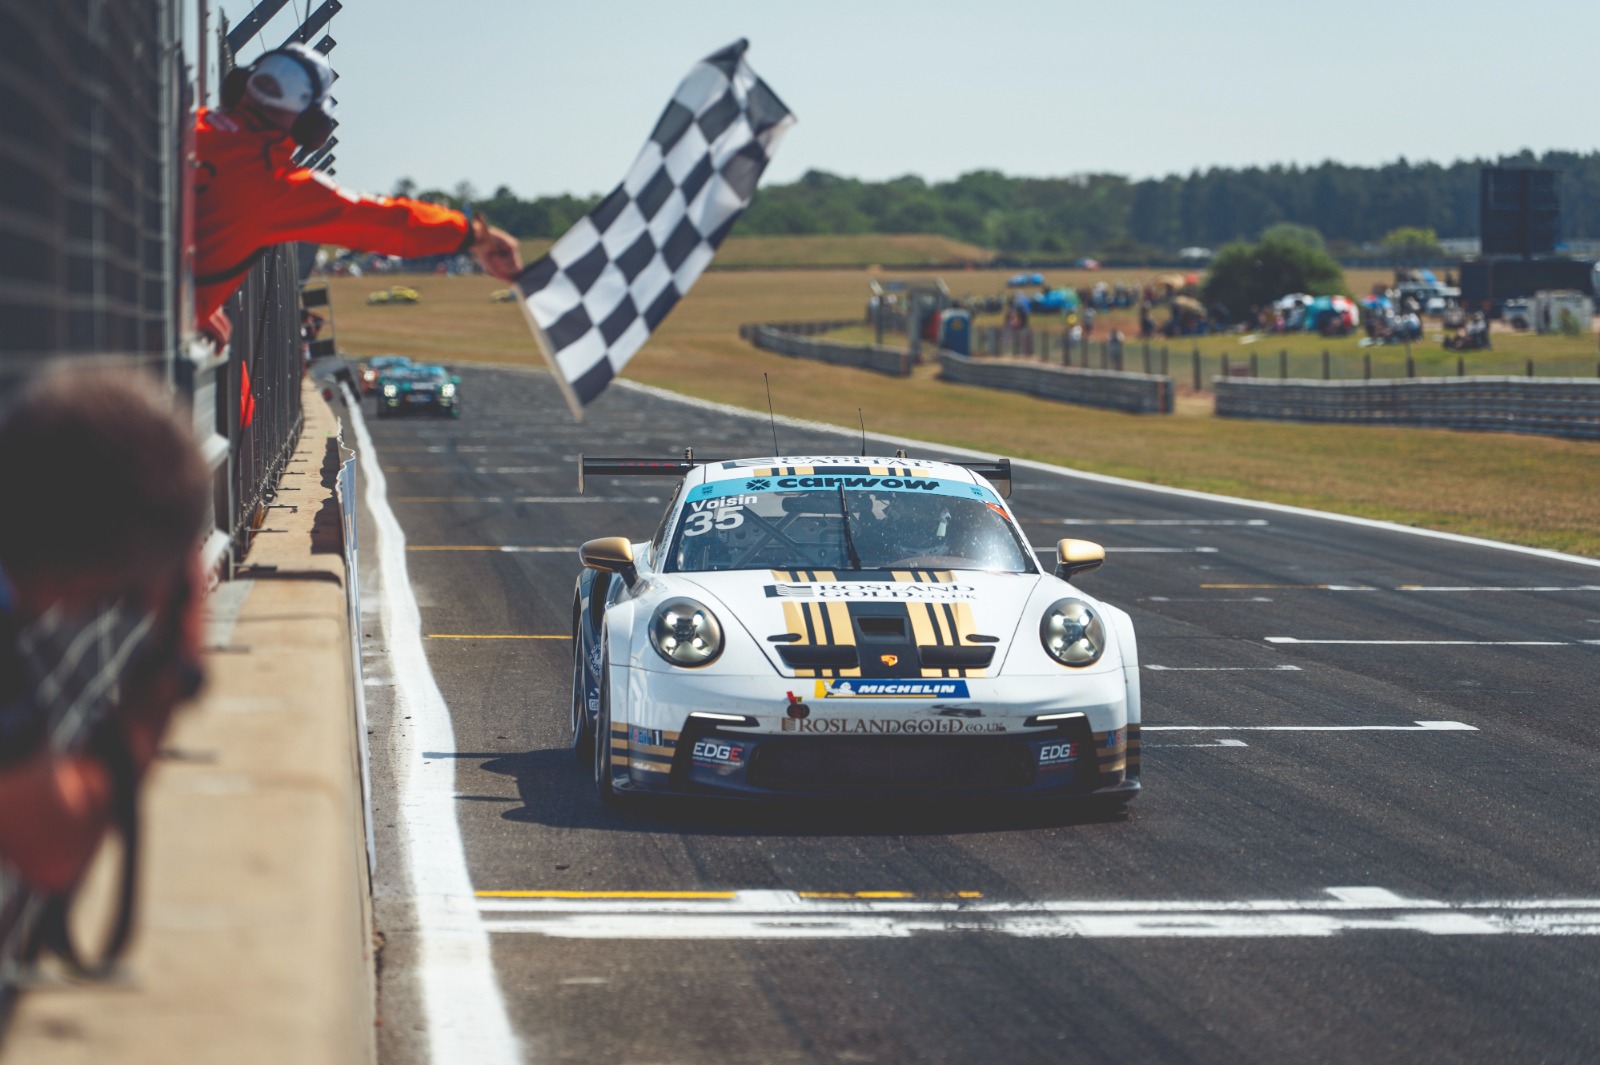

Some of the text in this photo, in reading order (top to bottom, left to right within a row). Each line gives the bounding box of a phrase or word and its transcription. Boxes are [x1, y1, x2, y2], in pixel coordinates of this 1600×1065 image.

[777, 477, 940, 491] carwow
[691, 494, 758, 512] Voisin
[684, 505, 744, 537] 35
[857, 685, 956, 694] MICHELIN
[692, 742, 743, 762] EDGE
[1040, 742, 1079, 760] EDGE
